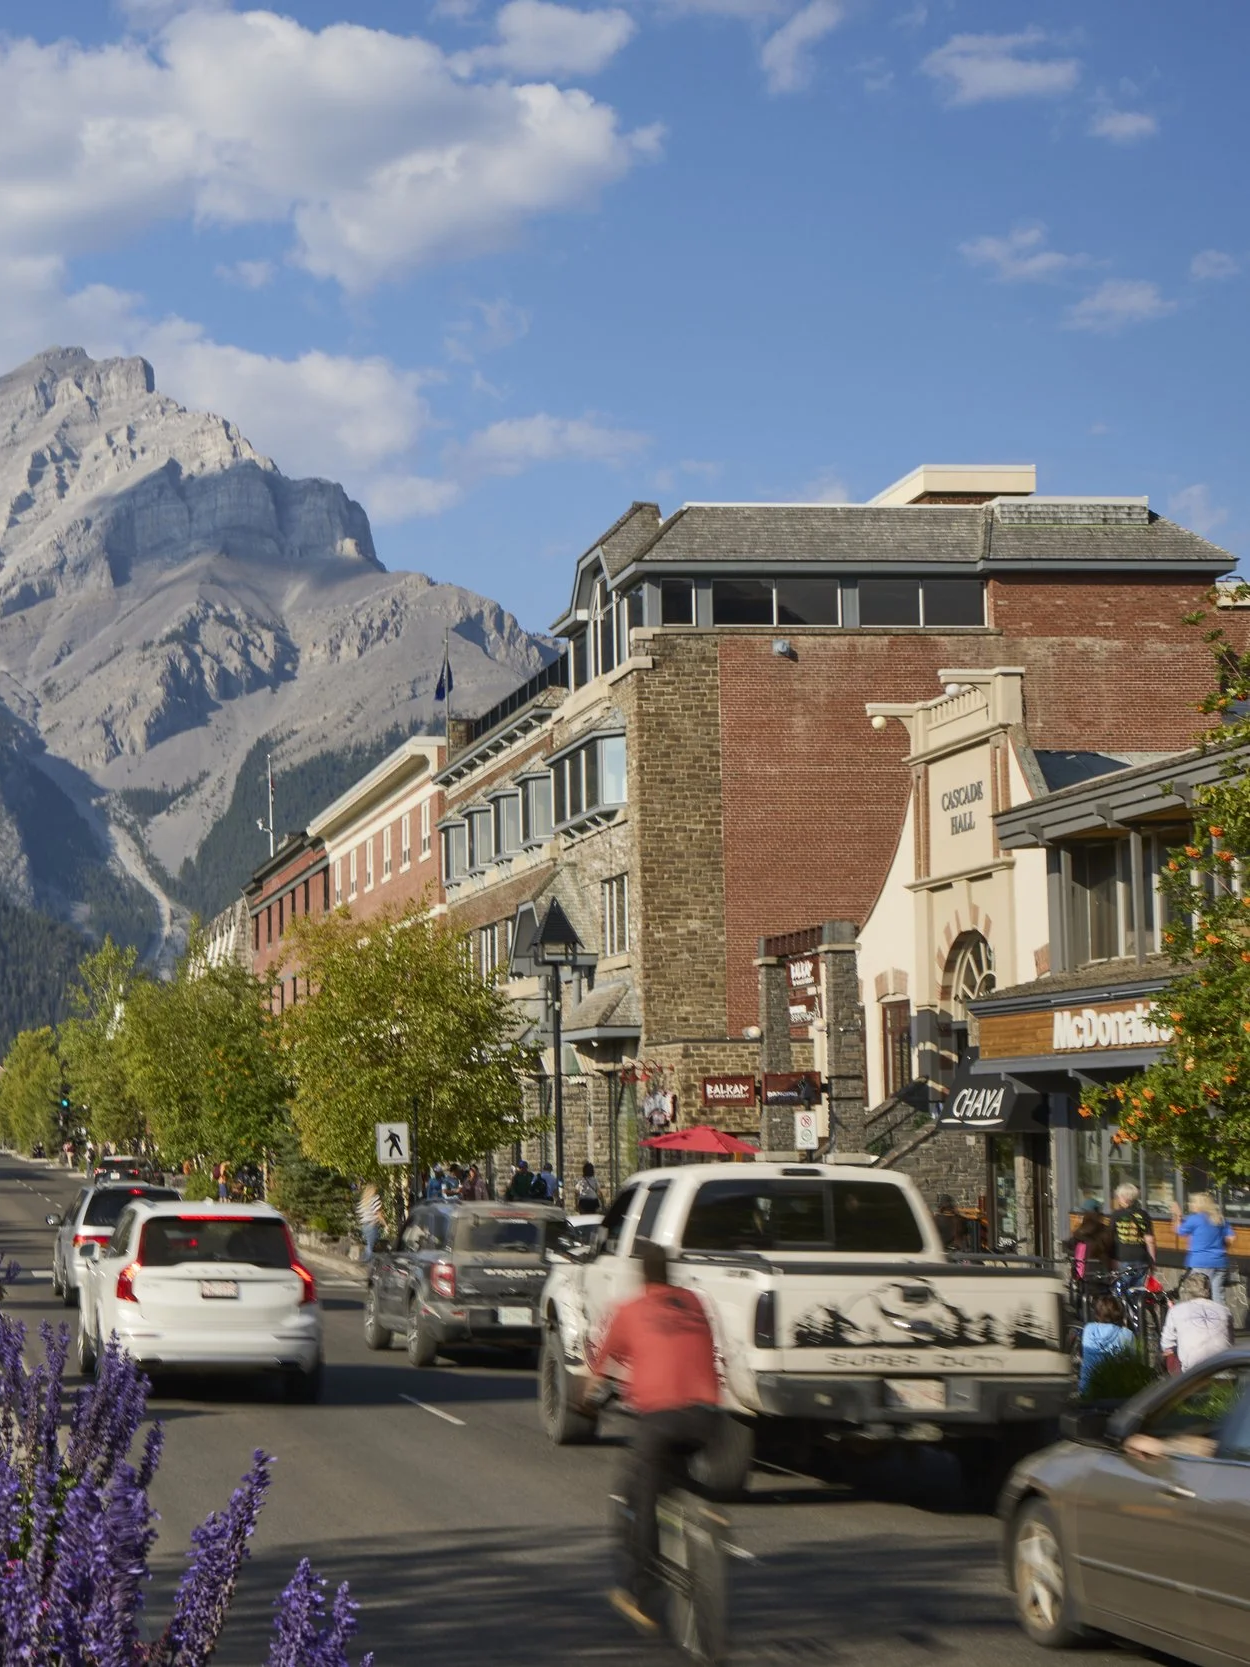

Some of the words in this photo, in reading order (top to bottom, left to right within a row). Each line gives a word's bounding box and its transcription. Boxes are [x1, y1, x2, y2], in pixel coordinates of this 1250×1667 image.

[941, 780, 984, 812] CASCADE
[950, 811, 976, 836] HALL
[1053, 1001, 1175, 1049] McDonalds
[706, 1083, 750, 1096] BALKAN
[952, 1088, 1005, 1117] CHAYA
[826, 1353, 920, 1367] SUPER
